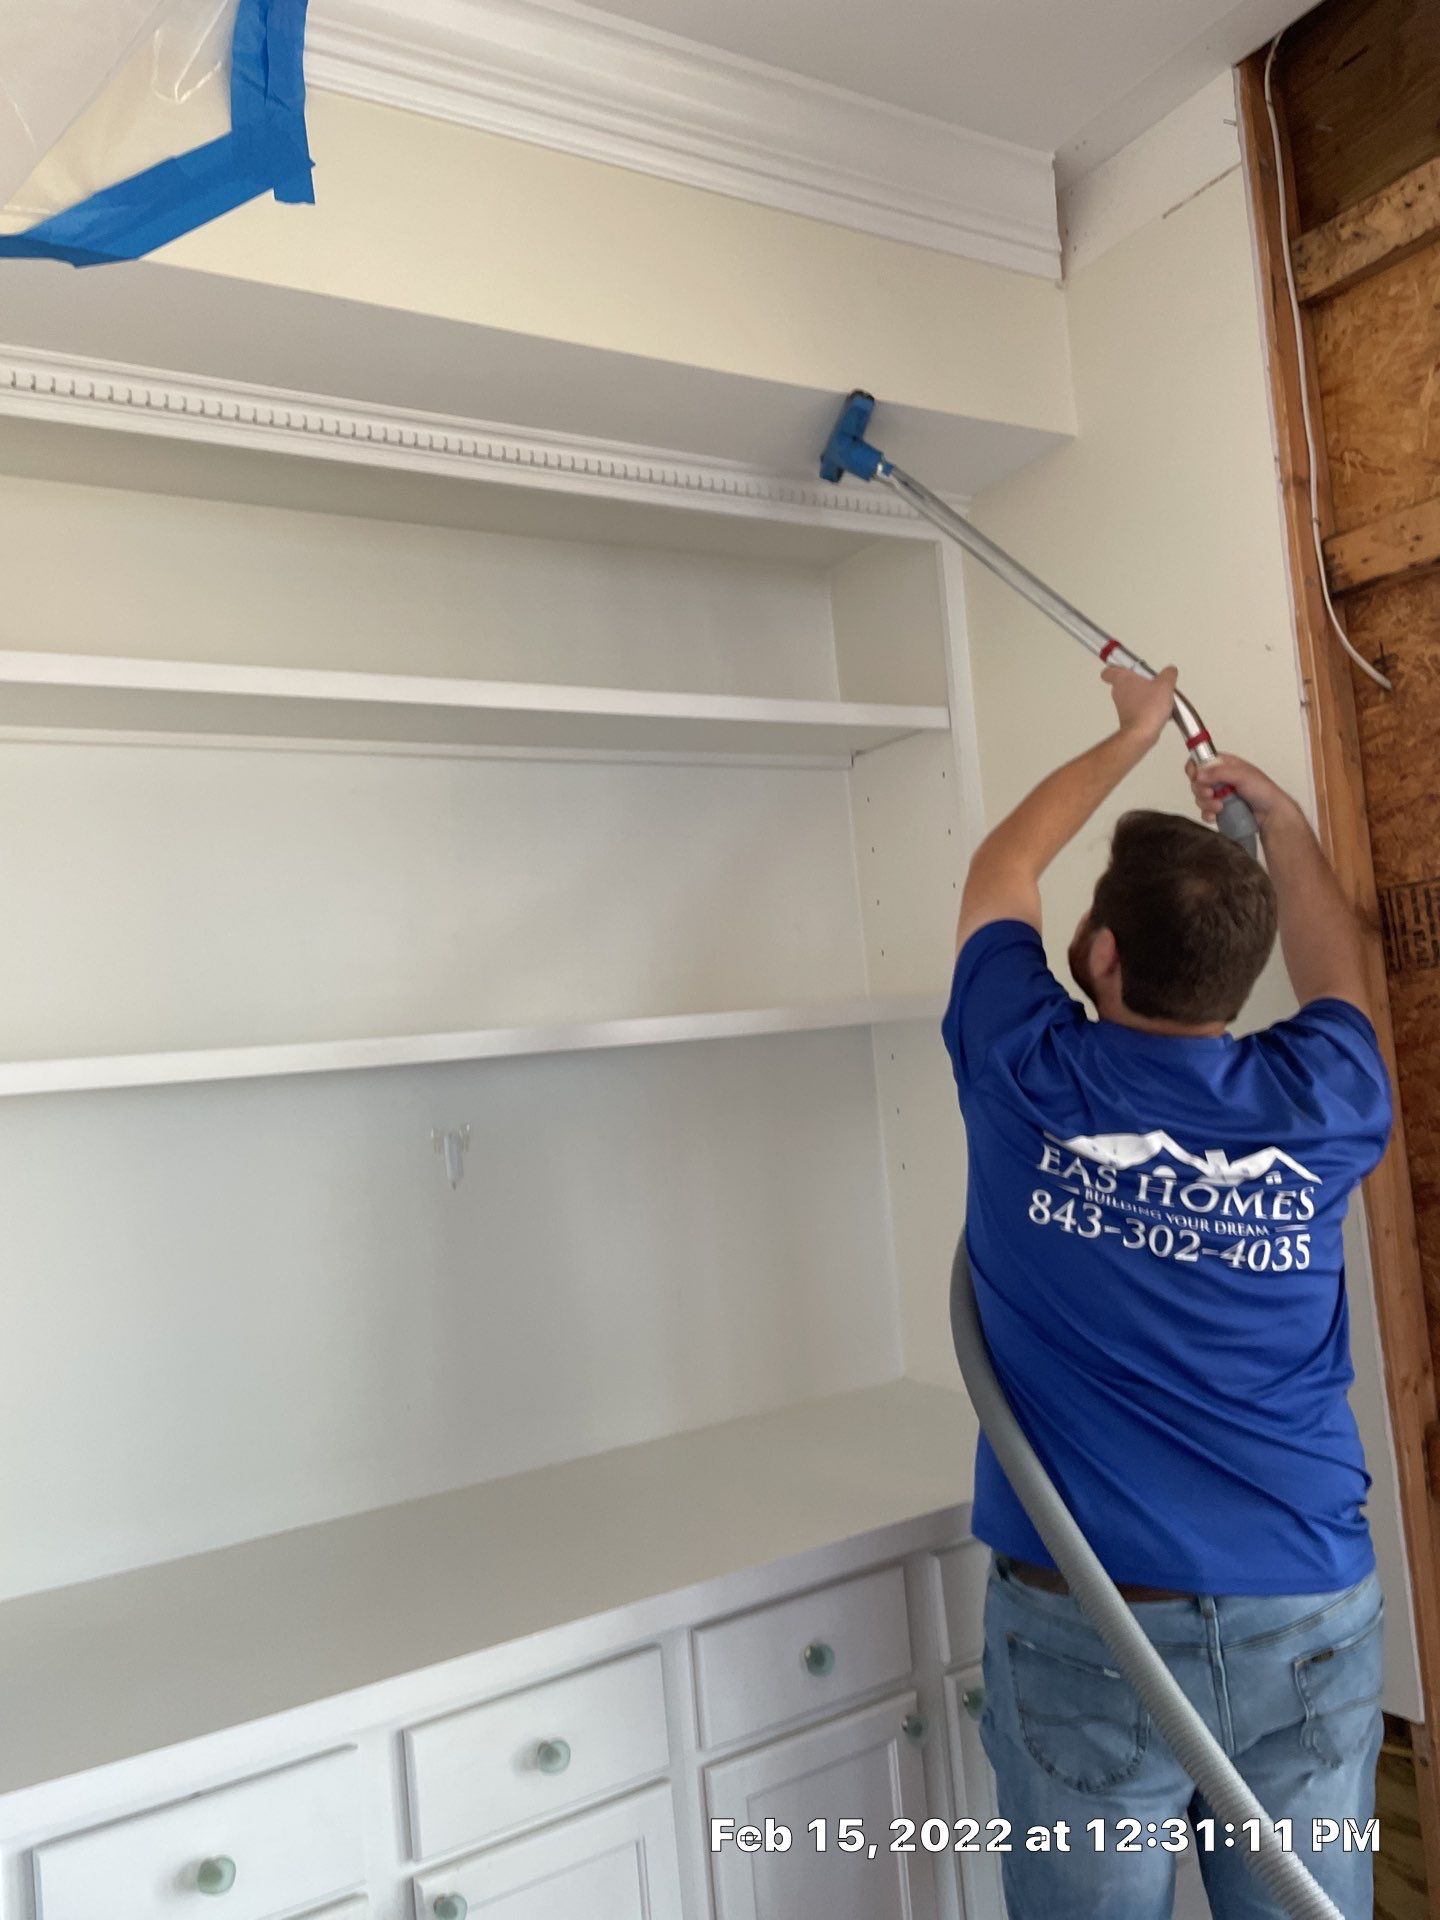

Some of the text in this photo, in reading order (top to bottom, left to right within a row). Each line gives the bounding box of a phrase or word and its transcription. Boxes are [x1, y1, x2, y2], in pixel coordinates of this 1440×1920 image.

[1037, 1144, 1315, 1221] EAS HOMES
[1084, 1186, 1270, 1237] BUILDING YOUR DREAM
[1028, 1189, 1311, 1272] 843-302-4035
